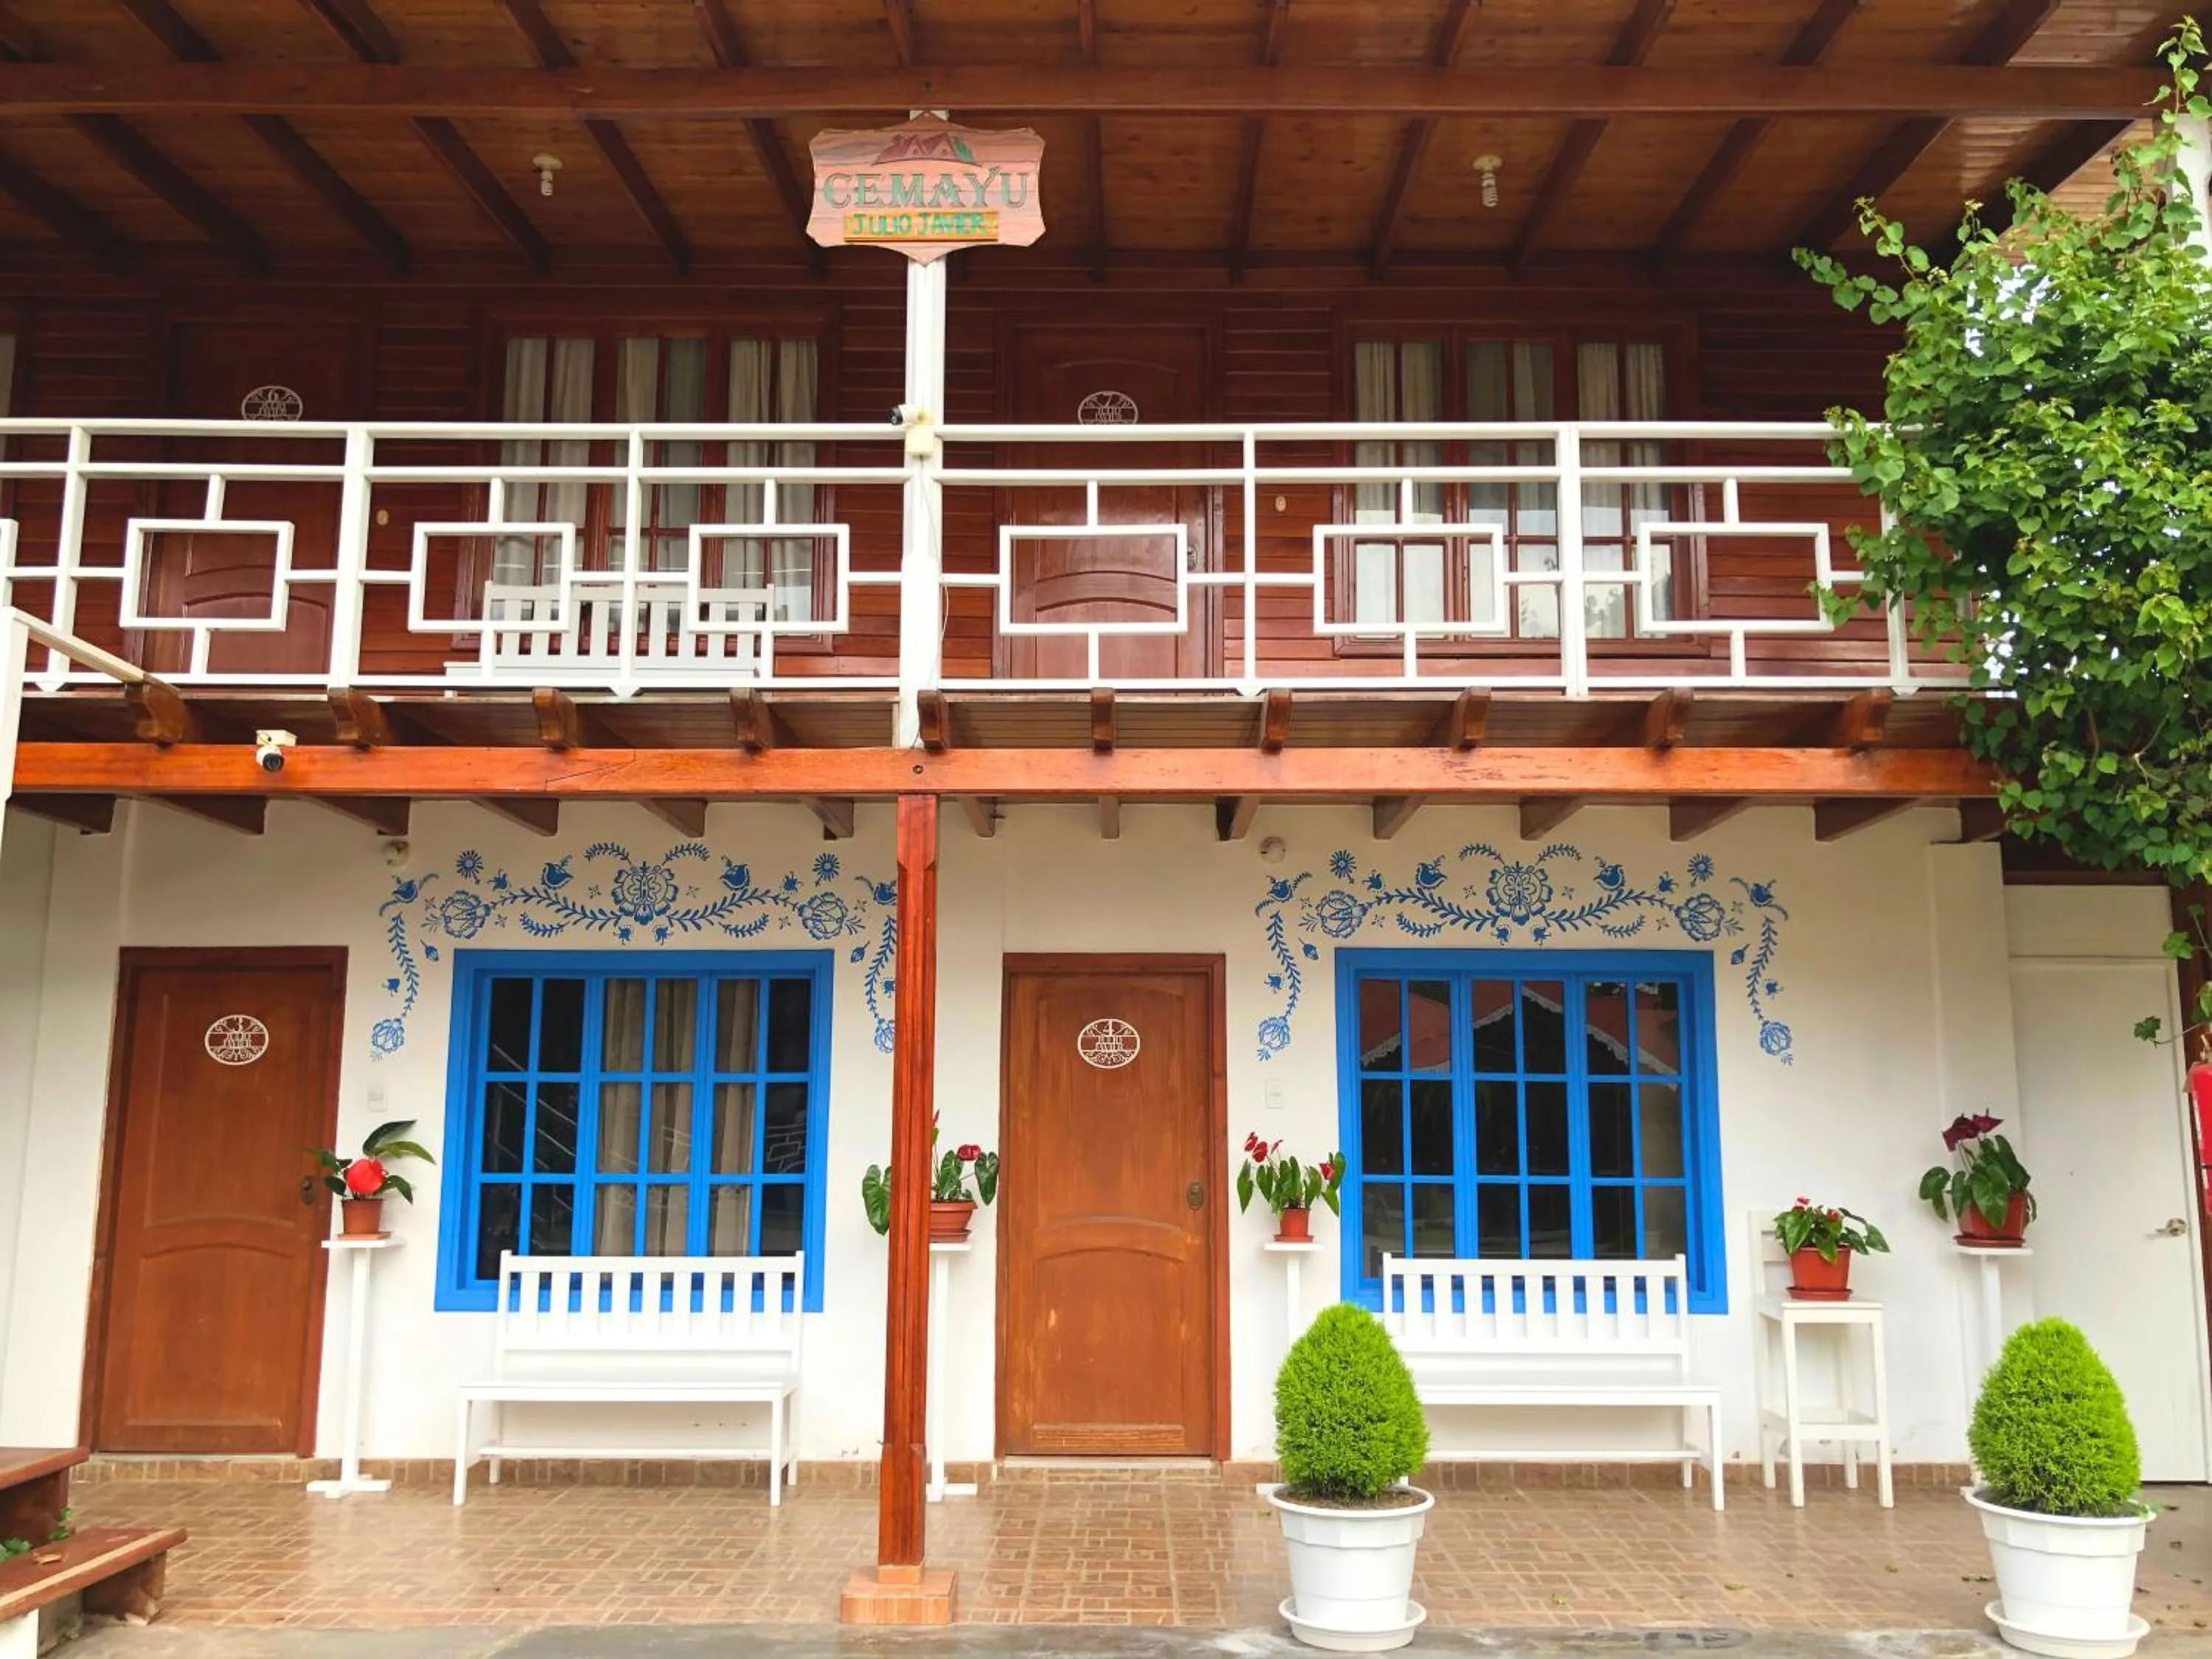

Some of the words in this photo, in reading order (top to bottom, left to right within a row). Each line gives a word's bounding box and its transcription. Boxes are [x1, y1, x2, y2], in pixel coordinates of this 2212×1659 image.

[823, 166, 1030, 209] CEMAYU
[853, 213, 912, 235] JULIO
[268, 388, 279, 403] 6
[1102, 1020, 1116, 1036] 4
